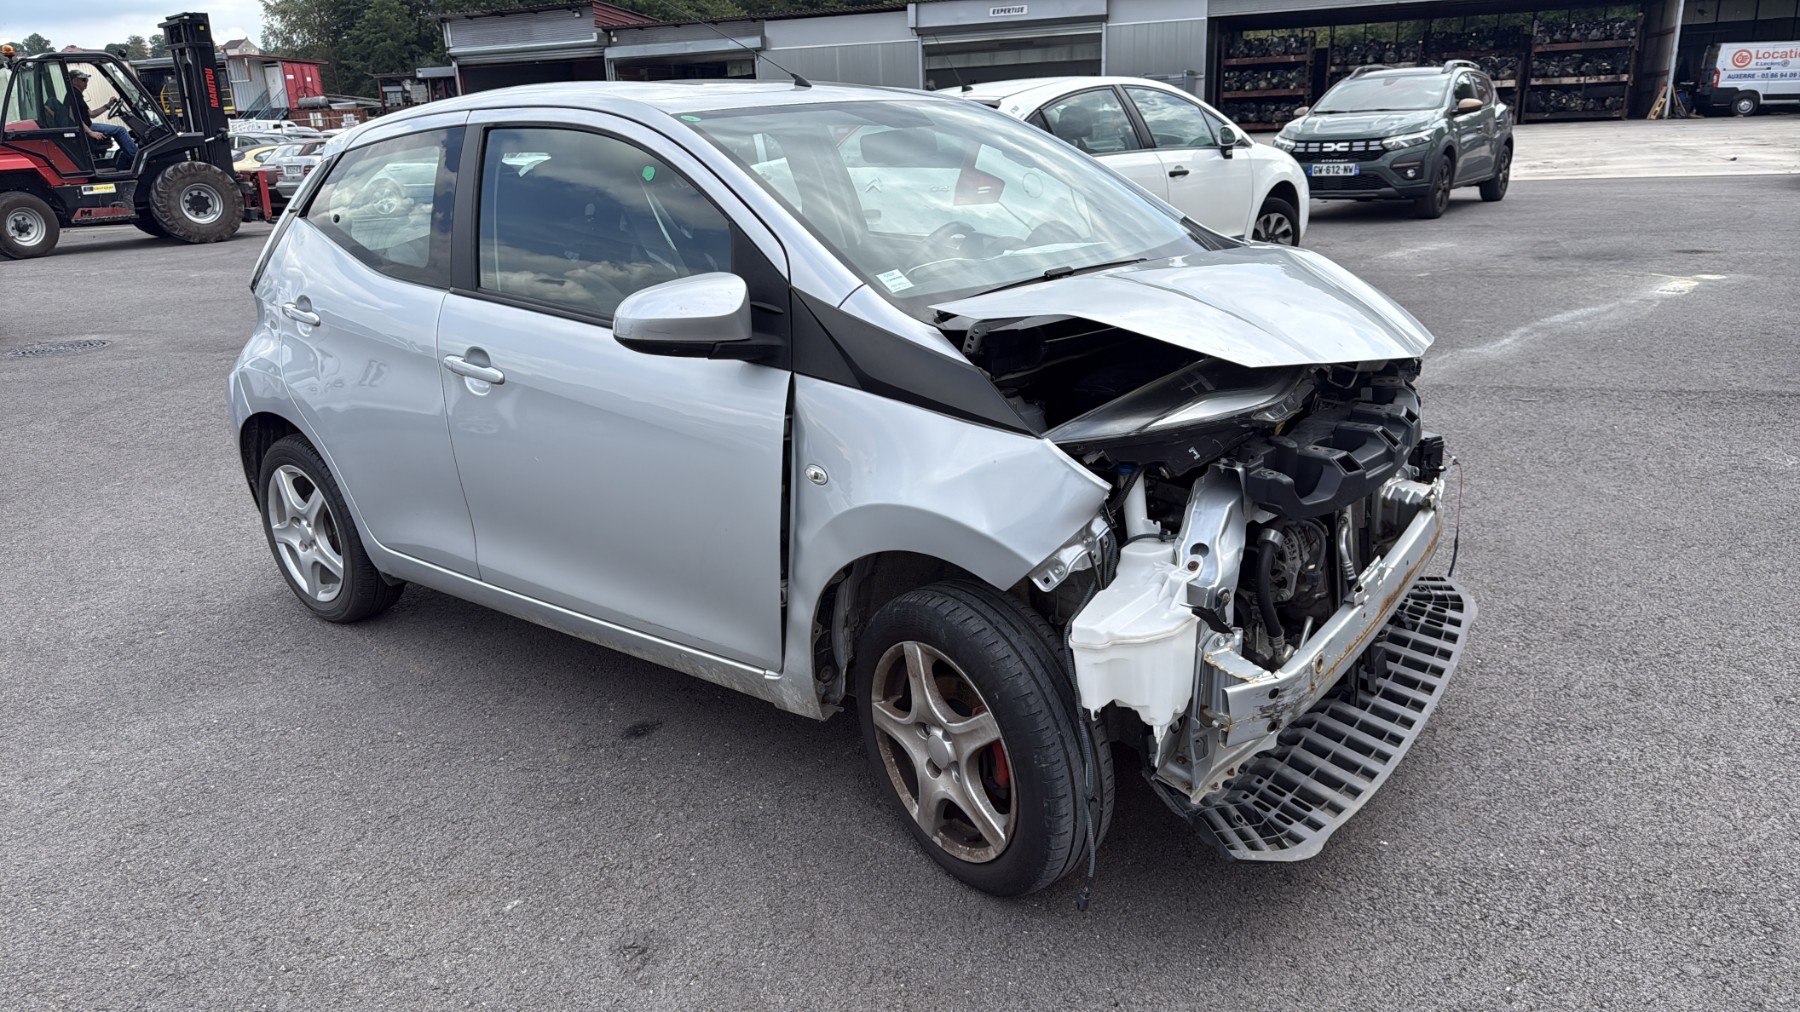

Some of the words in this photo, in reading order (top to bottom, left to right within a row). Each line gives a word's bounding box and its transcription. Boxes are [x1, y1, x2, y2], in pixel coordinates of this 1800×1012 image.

[992, 6, 1024, 15] EXPERTISE
[1755, 48, 1800, 60] Locati
[204, 67, 219, 107] MANITOU
[1313, 165, 1354, 174] GW-612-NW
